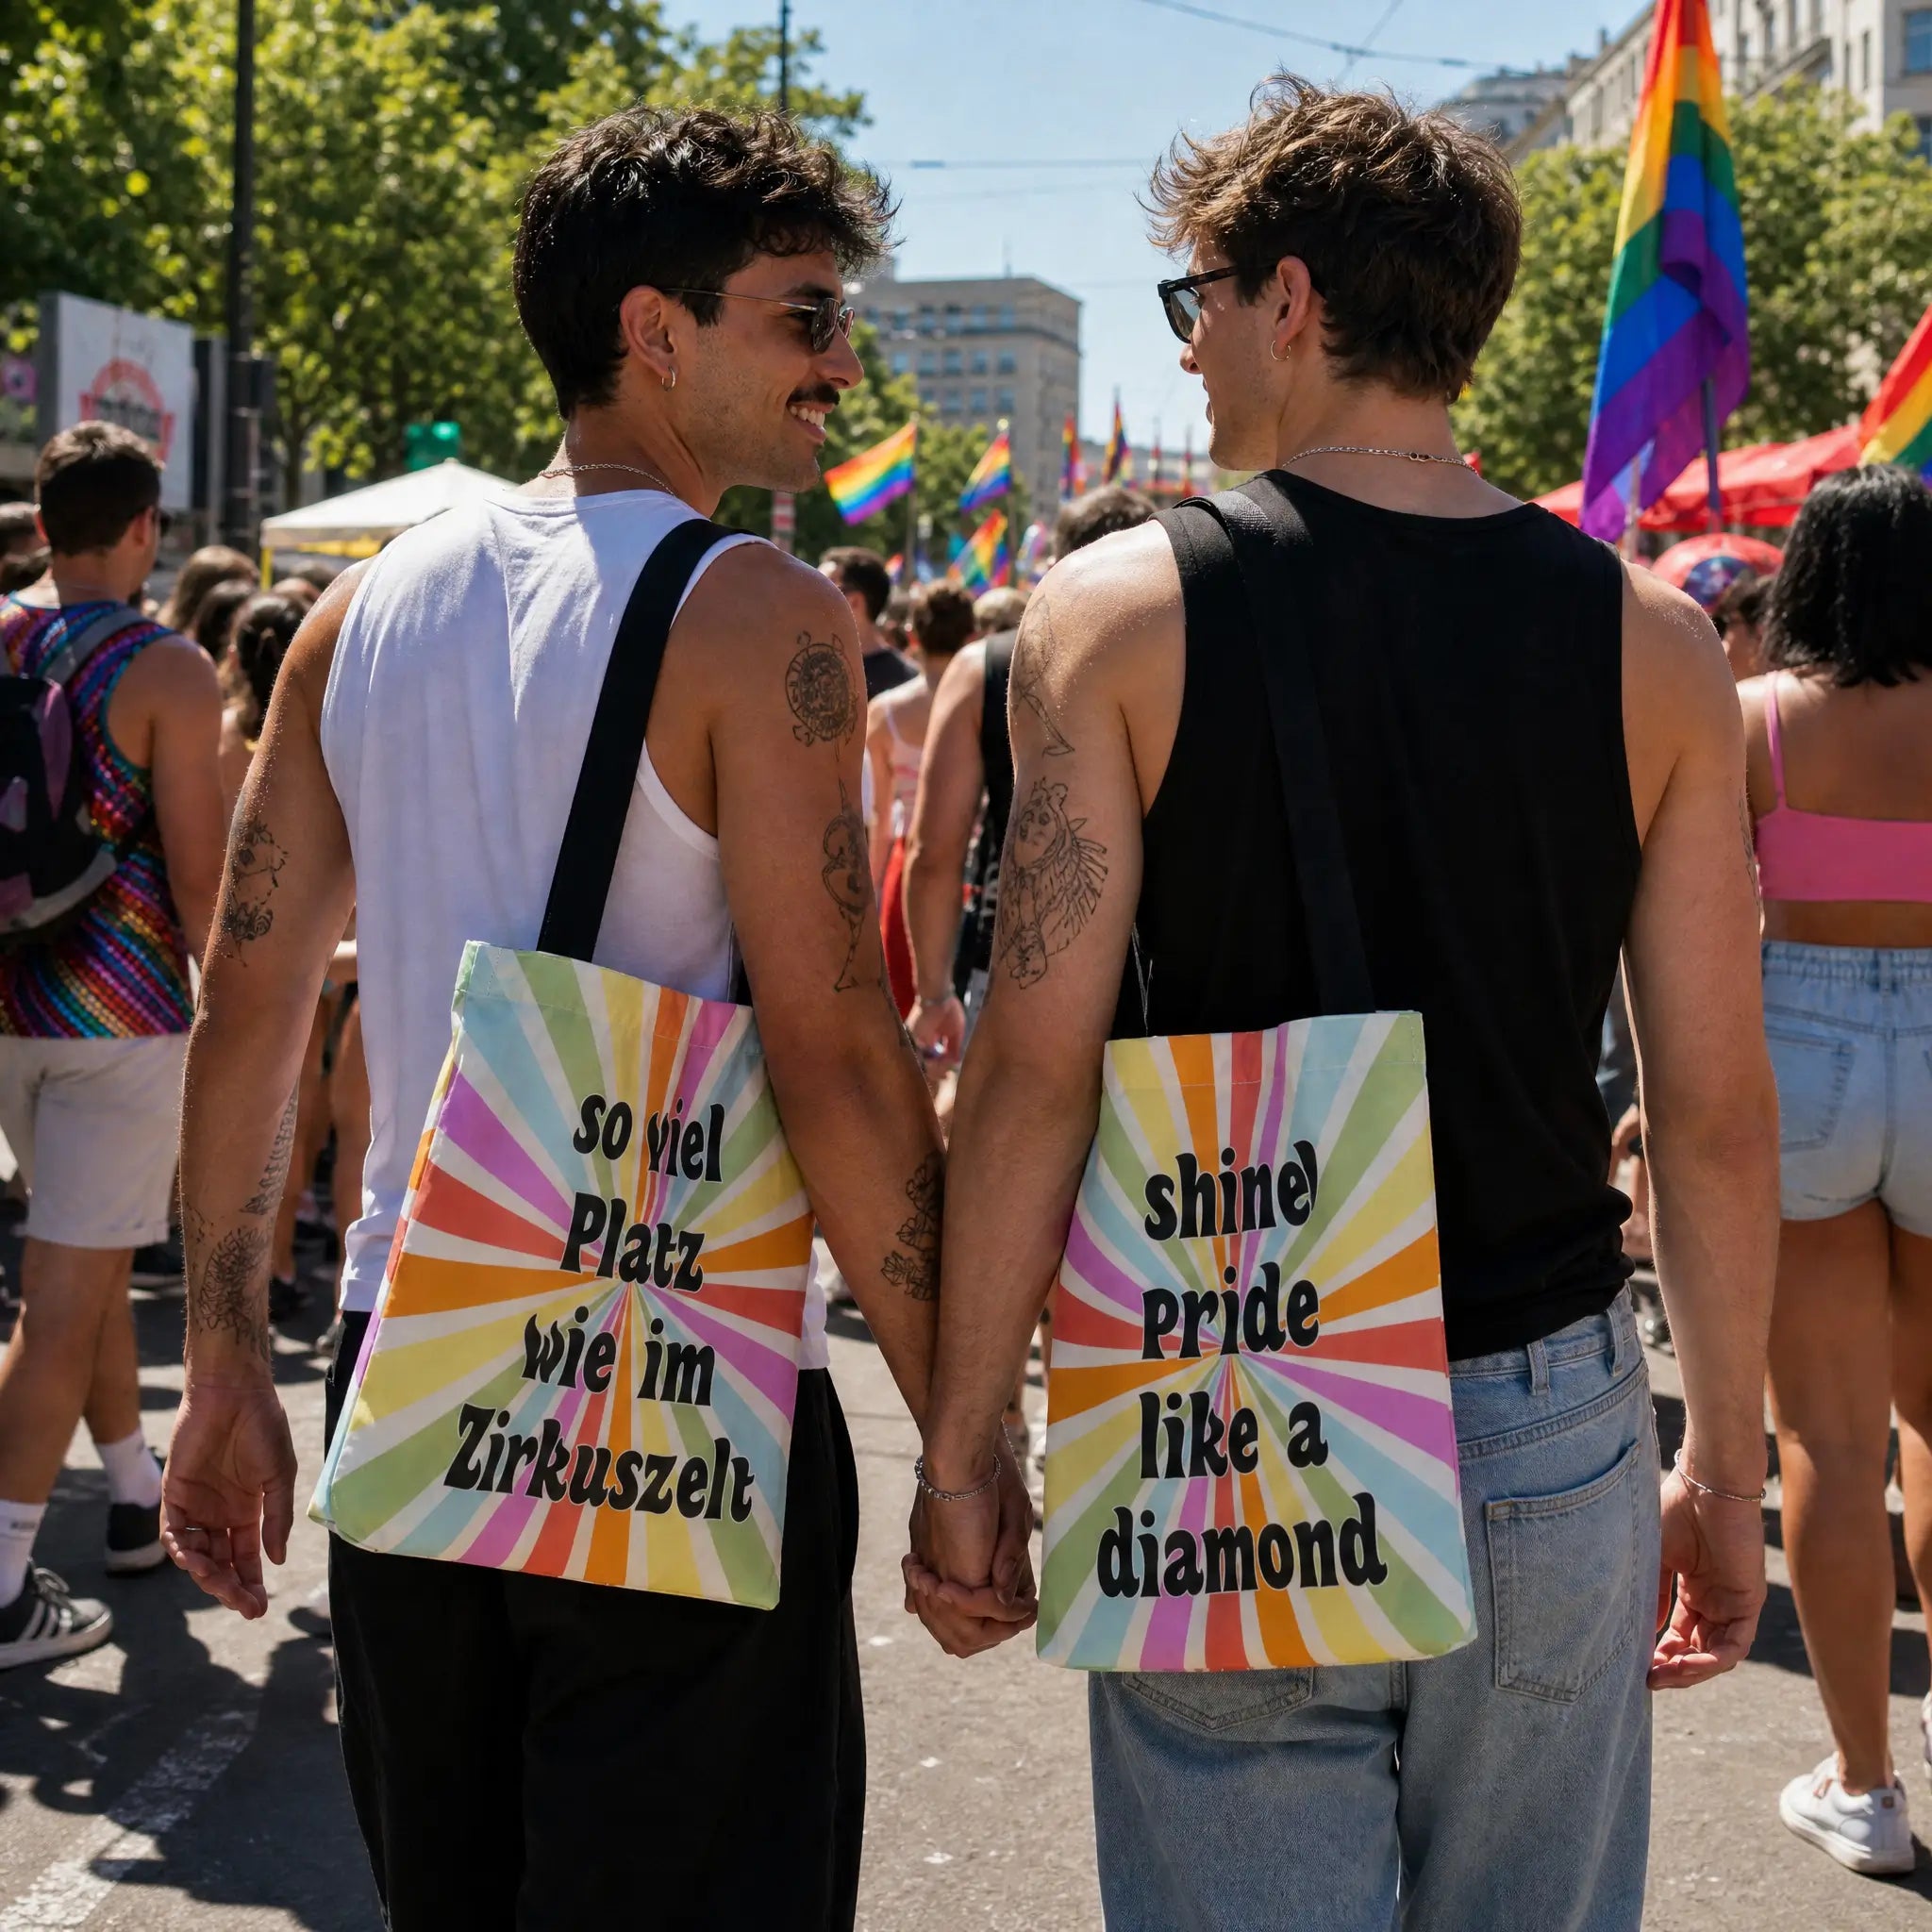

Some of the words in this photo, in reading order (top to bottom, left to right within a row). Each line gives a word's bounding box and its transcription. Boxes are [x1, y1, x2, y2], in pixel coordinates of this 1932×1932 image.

[573, 1094, 633, 1160] so
[646, 1097, 725, 1183] viel
[559, 1191, 705, 1292] Platz
[521, 1306, 617, 1393] wie
[637, 1318, 715, 1407] im
[443, 1403, 755, 1523] Zirkuszelt
[1139, 1391, 1258, 1479] like
[1287, 1401, 1329, 1468] a
[1096, 1491, 1388, 1598] diamond
